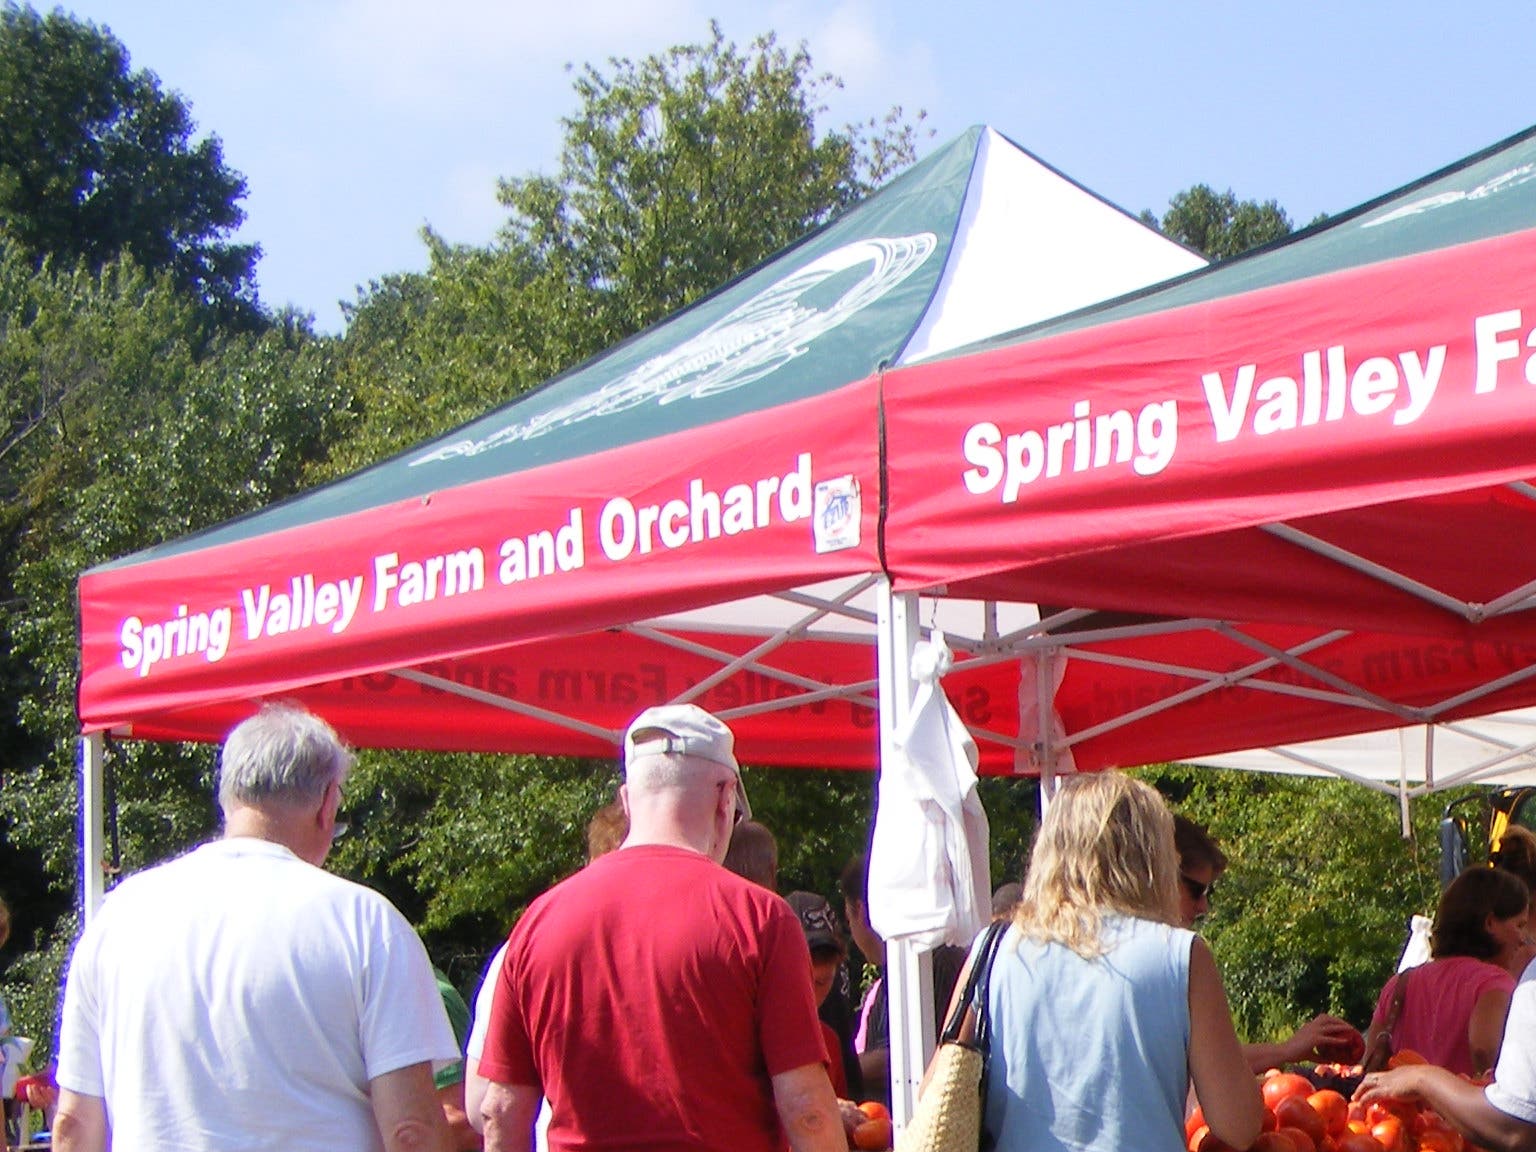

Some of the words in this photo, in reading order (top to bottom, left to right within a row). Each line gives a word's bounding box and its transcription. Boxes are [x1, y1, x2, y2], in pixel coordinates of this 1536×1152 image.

[964, 401, 1178, 503] Spring
[1202, 345, 1447, 443] Valley
[121, 602, 232, 678] Spring
[242, 574, 364, 641] Valley
[373, 547, 485, 613] Farm
[499, 508, 585, 586] and
[600, 453, 813, 561] Orchard
